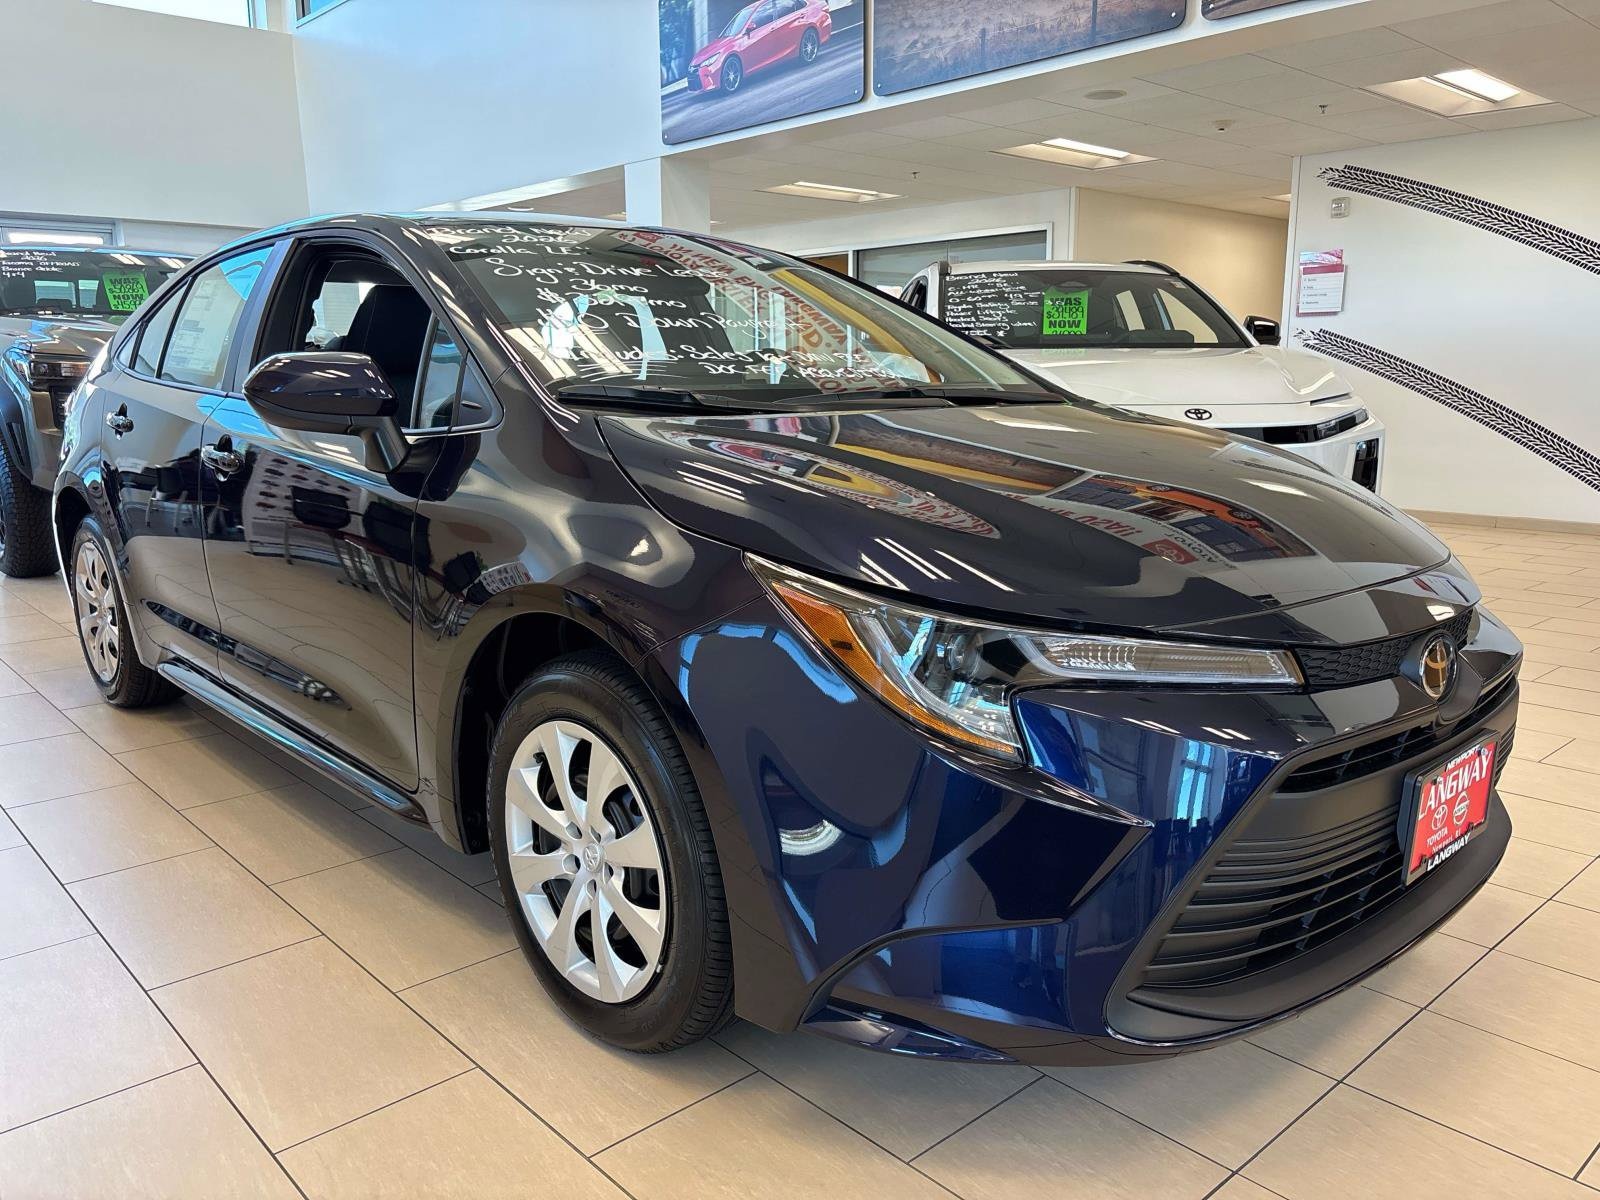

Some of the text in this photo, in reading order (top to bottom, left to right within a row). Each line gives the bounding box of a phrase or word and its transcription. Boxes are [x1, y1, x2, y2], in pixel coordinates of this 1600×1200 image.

[501, 234, 578, 244] 2026
[449, 245, 539, 255] Corolla
[1050, 297, 1082, 306] WAS
[1048, 320, 1082, 328] NOW
[1418, 751, 1492, 820] LANGWAY
[1427, 827, 1449, 846] TOYOTA
[1426, 832, 1471, 872] LANGWAY
